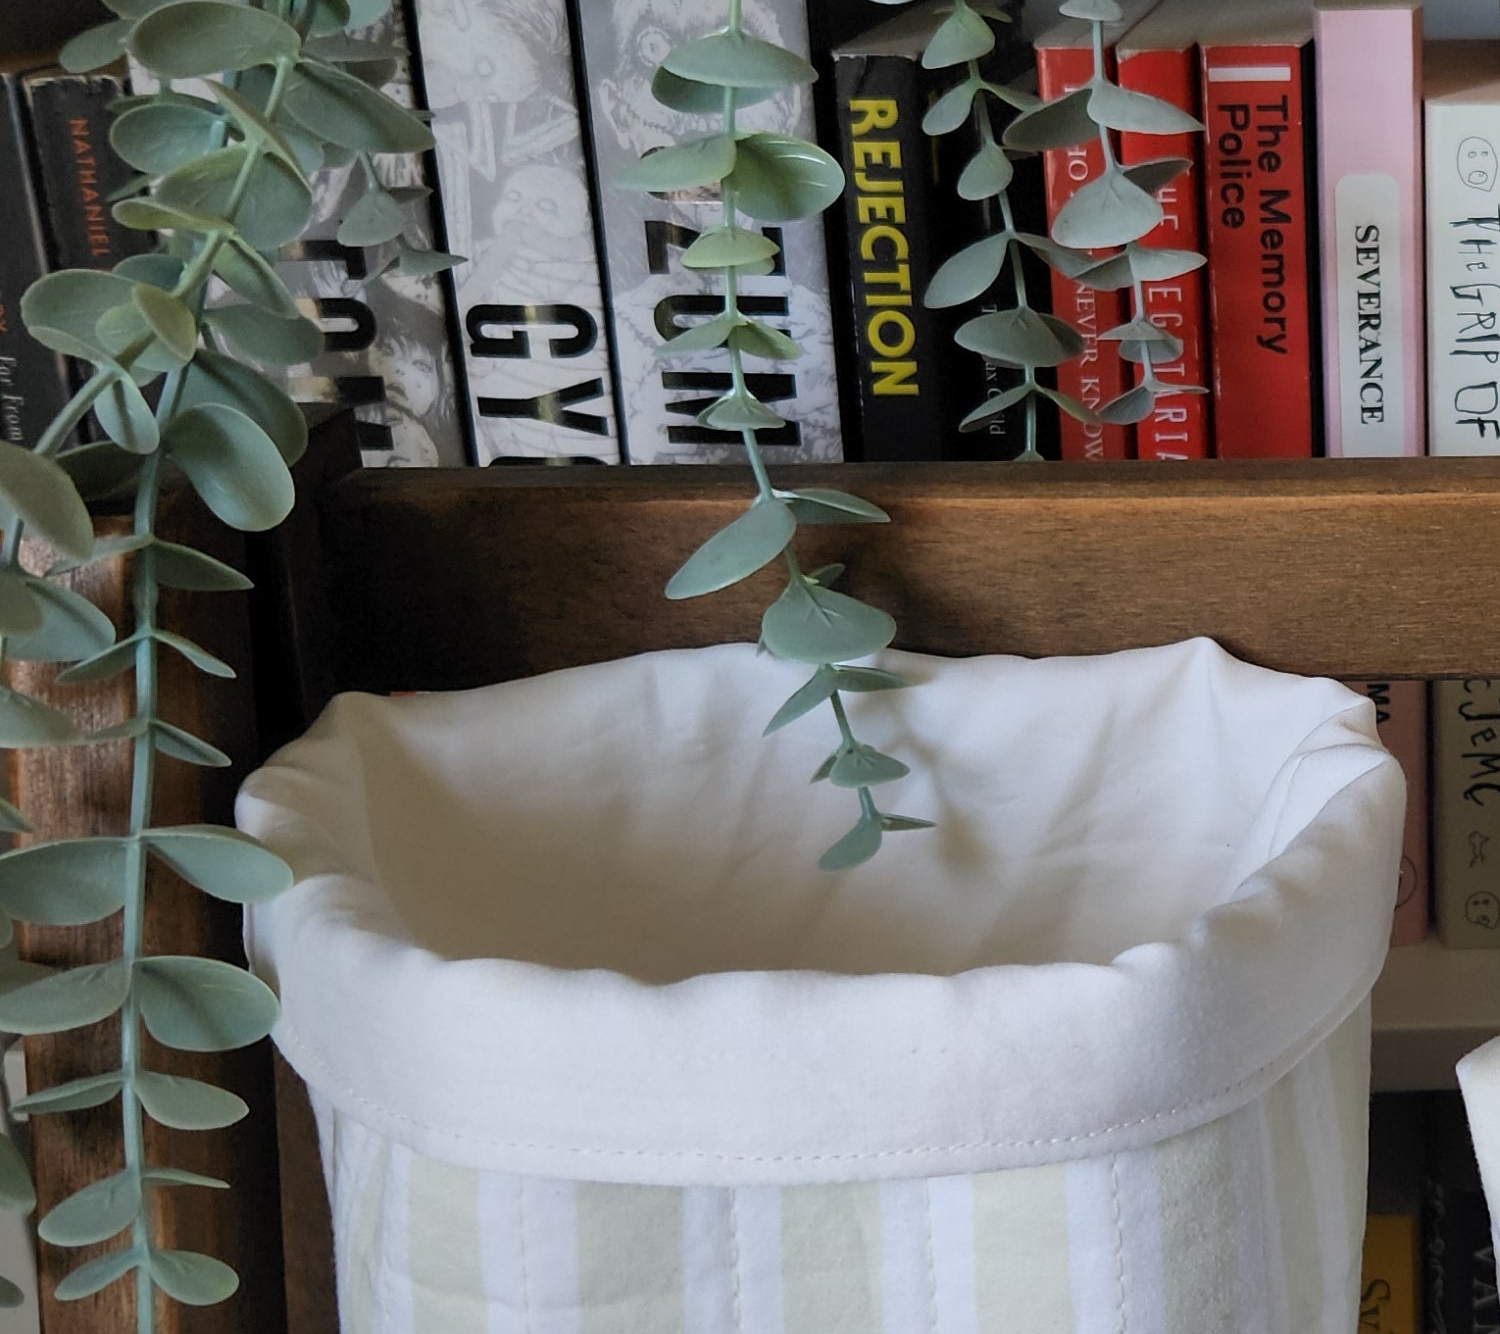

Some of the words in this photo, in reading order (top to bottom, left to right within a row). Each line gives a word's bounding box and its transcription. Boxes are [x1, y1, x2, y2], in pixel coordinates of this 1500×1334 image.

[68, 116, 111, 257] NATHANIEL
[1217, 103, 1251, 230] Police
[1257, 95, 1288, 174] The
[849, 98, 920, 397] REJECTION
[1256, 188, 1290, 356] Memory
[1355, 223, 1385, 426] SEVERANCE
[464, 303, 611, 466] GY
